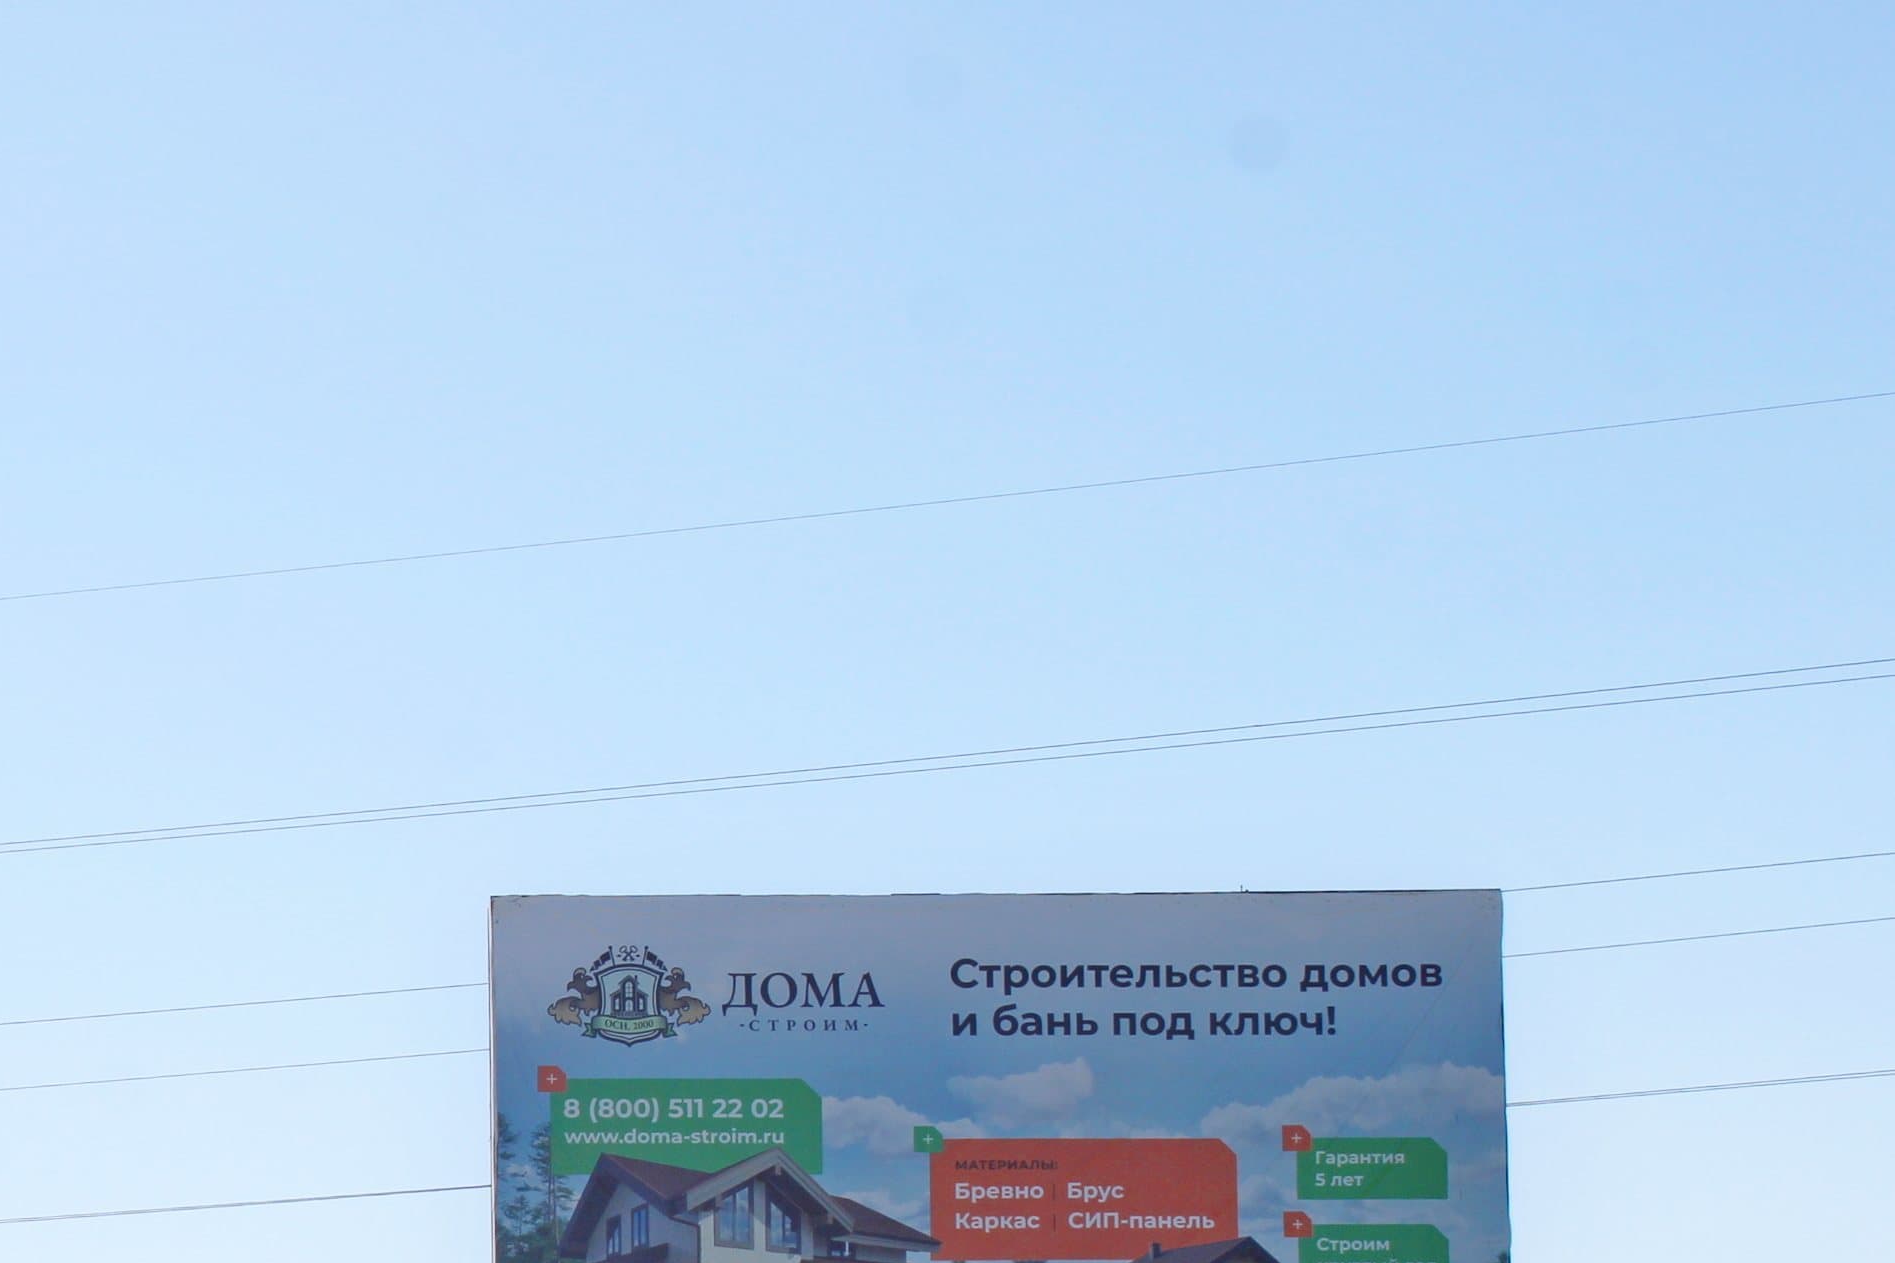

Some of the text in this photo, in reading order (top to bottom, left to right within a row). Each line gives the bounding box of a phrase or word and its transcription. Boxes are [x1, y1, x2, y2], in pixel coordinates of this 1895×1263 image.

[950, 958, 1443, 996] Строительство домов
[722, 971, 886, 1016] ДОМА
[633, 1019, 655, 1030] 2000
[952, 1003, 1336, 1040] и бань под ключ!
[563, 1098, 784, 1123] 8 (800) 511 22 02
[564, 1127, 785, 1145] www.doma-stroim.ru
[1315, 1151, 1406, 1167] Гарантия
[1315, 1173, 1365, 1187] 5 лет
[955, 1182, 1125, 1203] Бревно Брус
[955, 1212, 1216, 1233] Каркас СИП-панель
[1316, 1237, 1390, 1254] Строим
